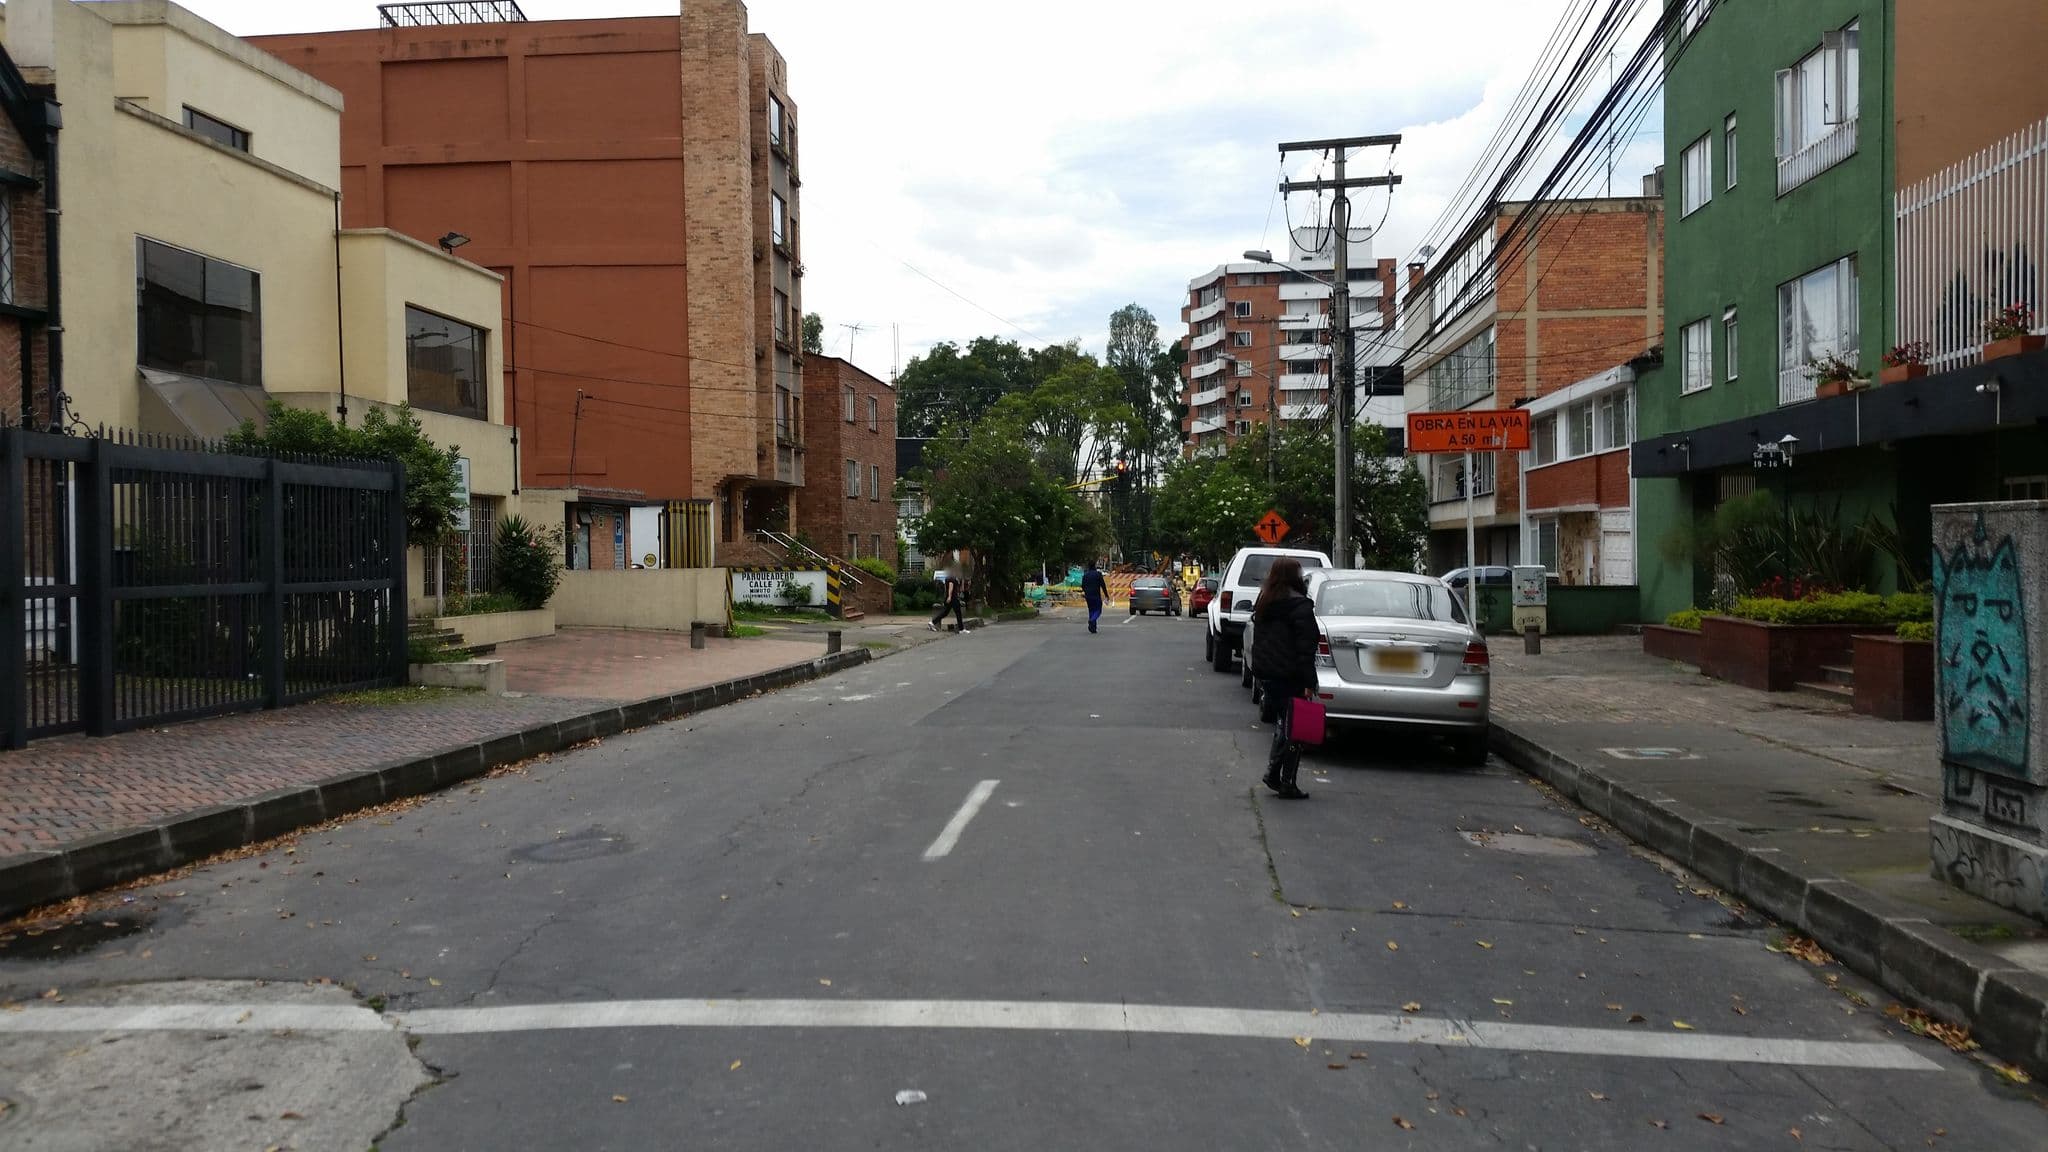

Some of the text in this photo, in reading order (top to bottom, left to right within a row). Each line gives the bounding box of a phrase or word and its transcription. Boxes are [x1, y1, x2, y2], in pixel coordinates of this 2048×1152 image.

[1415, 415, 1522, 431] OBRA EN LA VIA
[1448, 434, 1458, 446] A
[1462, 434, 1476, 445] 50
[742, 572, 794, 580] PARQUEADERO
